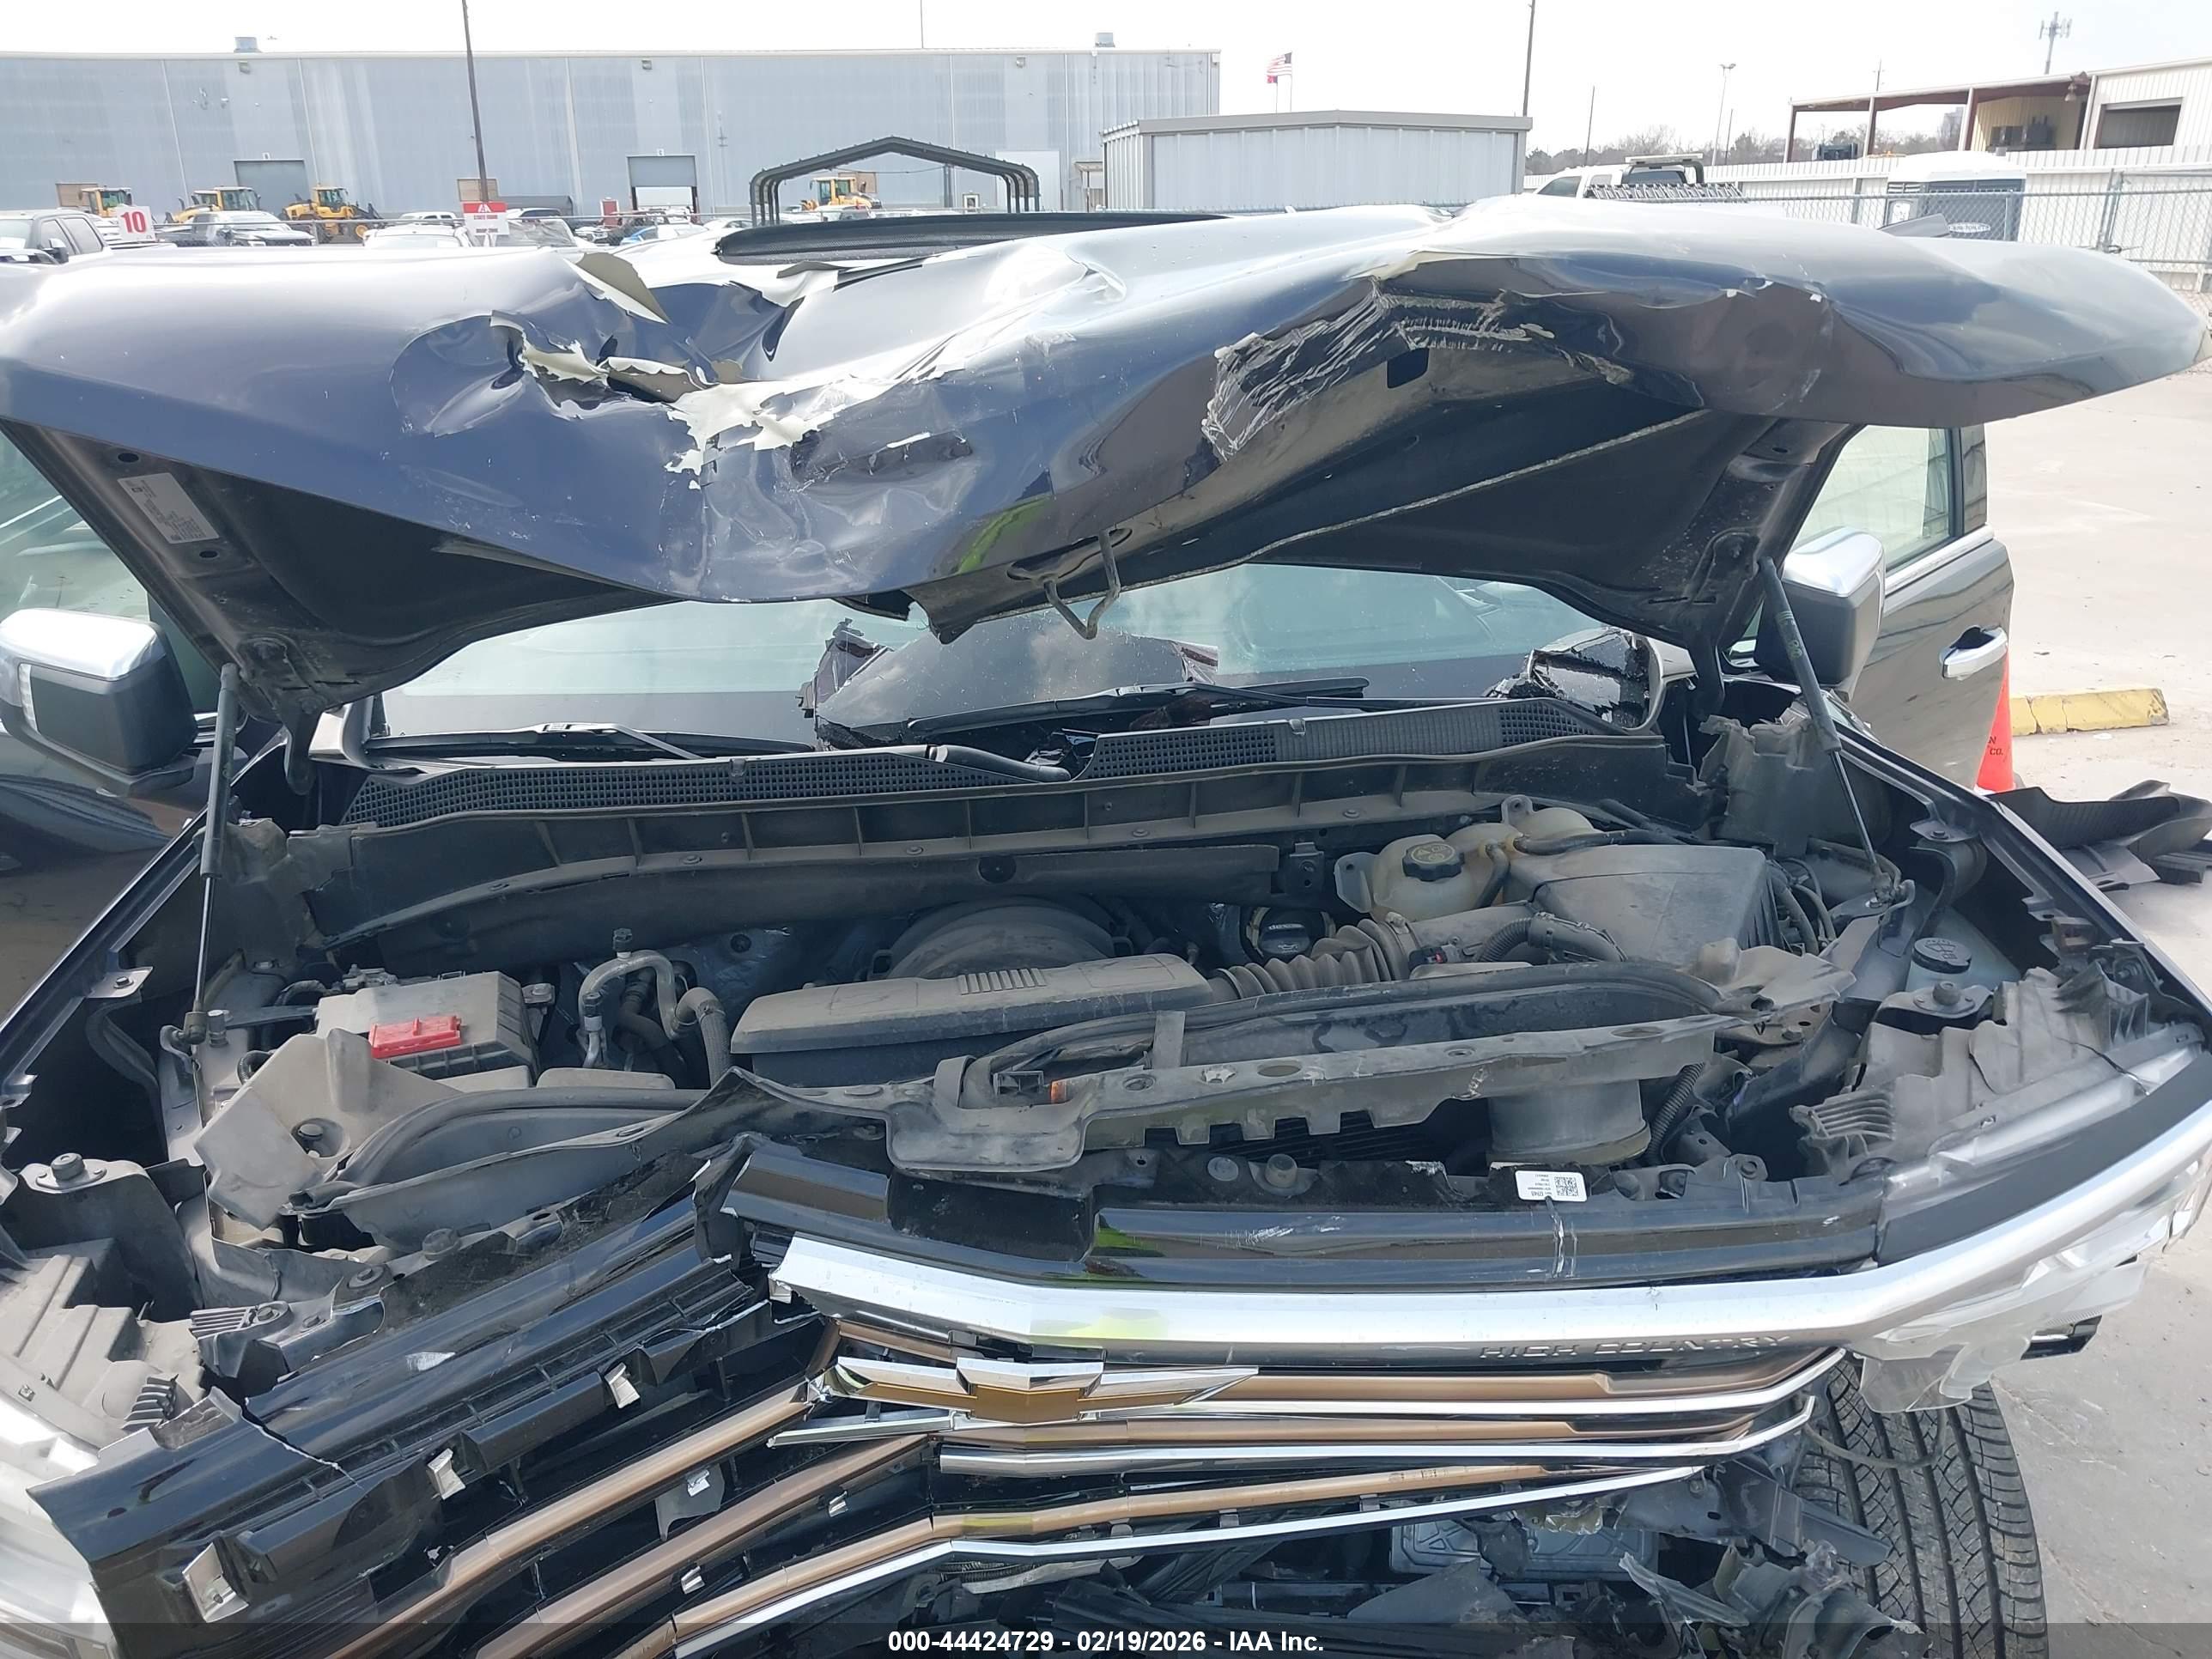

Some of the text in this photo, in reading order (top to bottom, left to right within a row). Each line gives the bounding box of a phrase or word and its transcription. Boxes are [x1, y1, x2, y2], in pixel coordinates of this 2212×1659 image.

[120, 210, 147, 234] 10
[1480, 1335, 1790, 1359] HIGH COUNTRY
